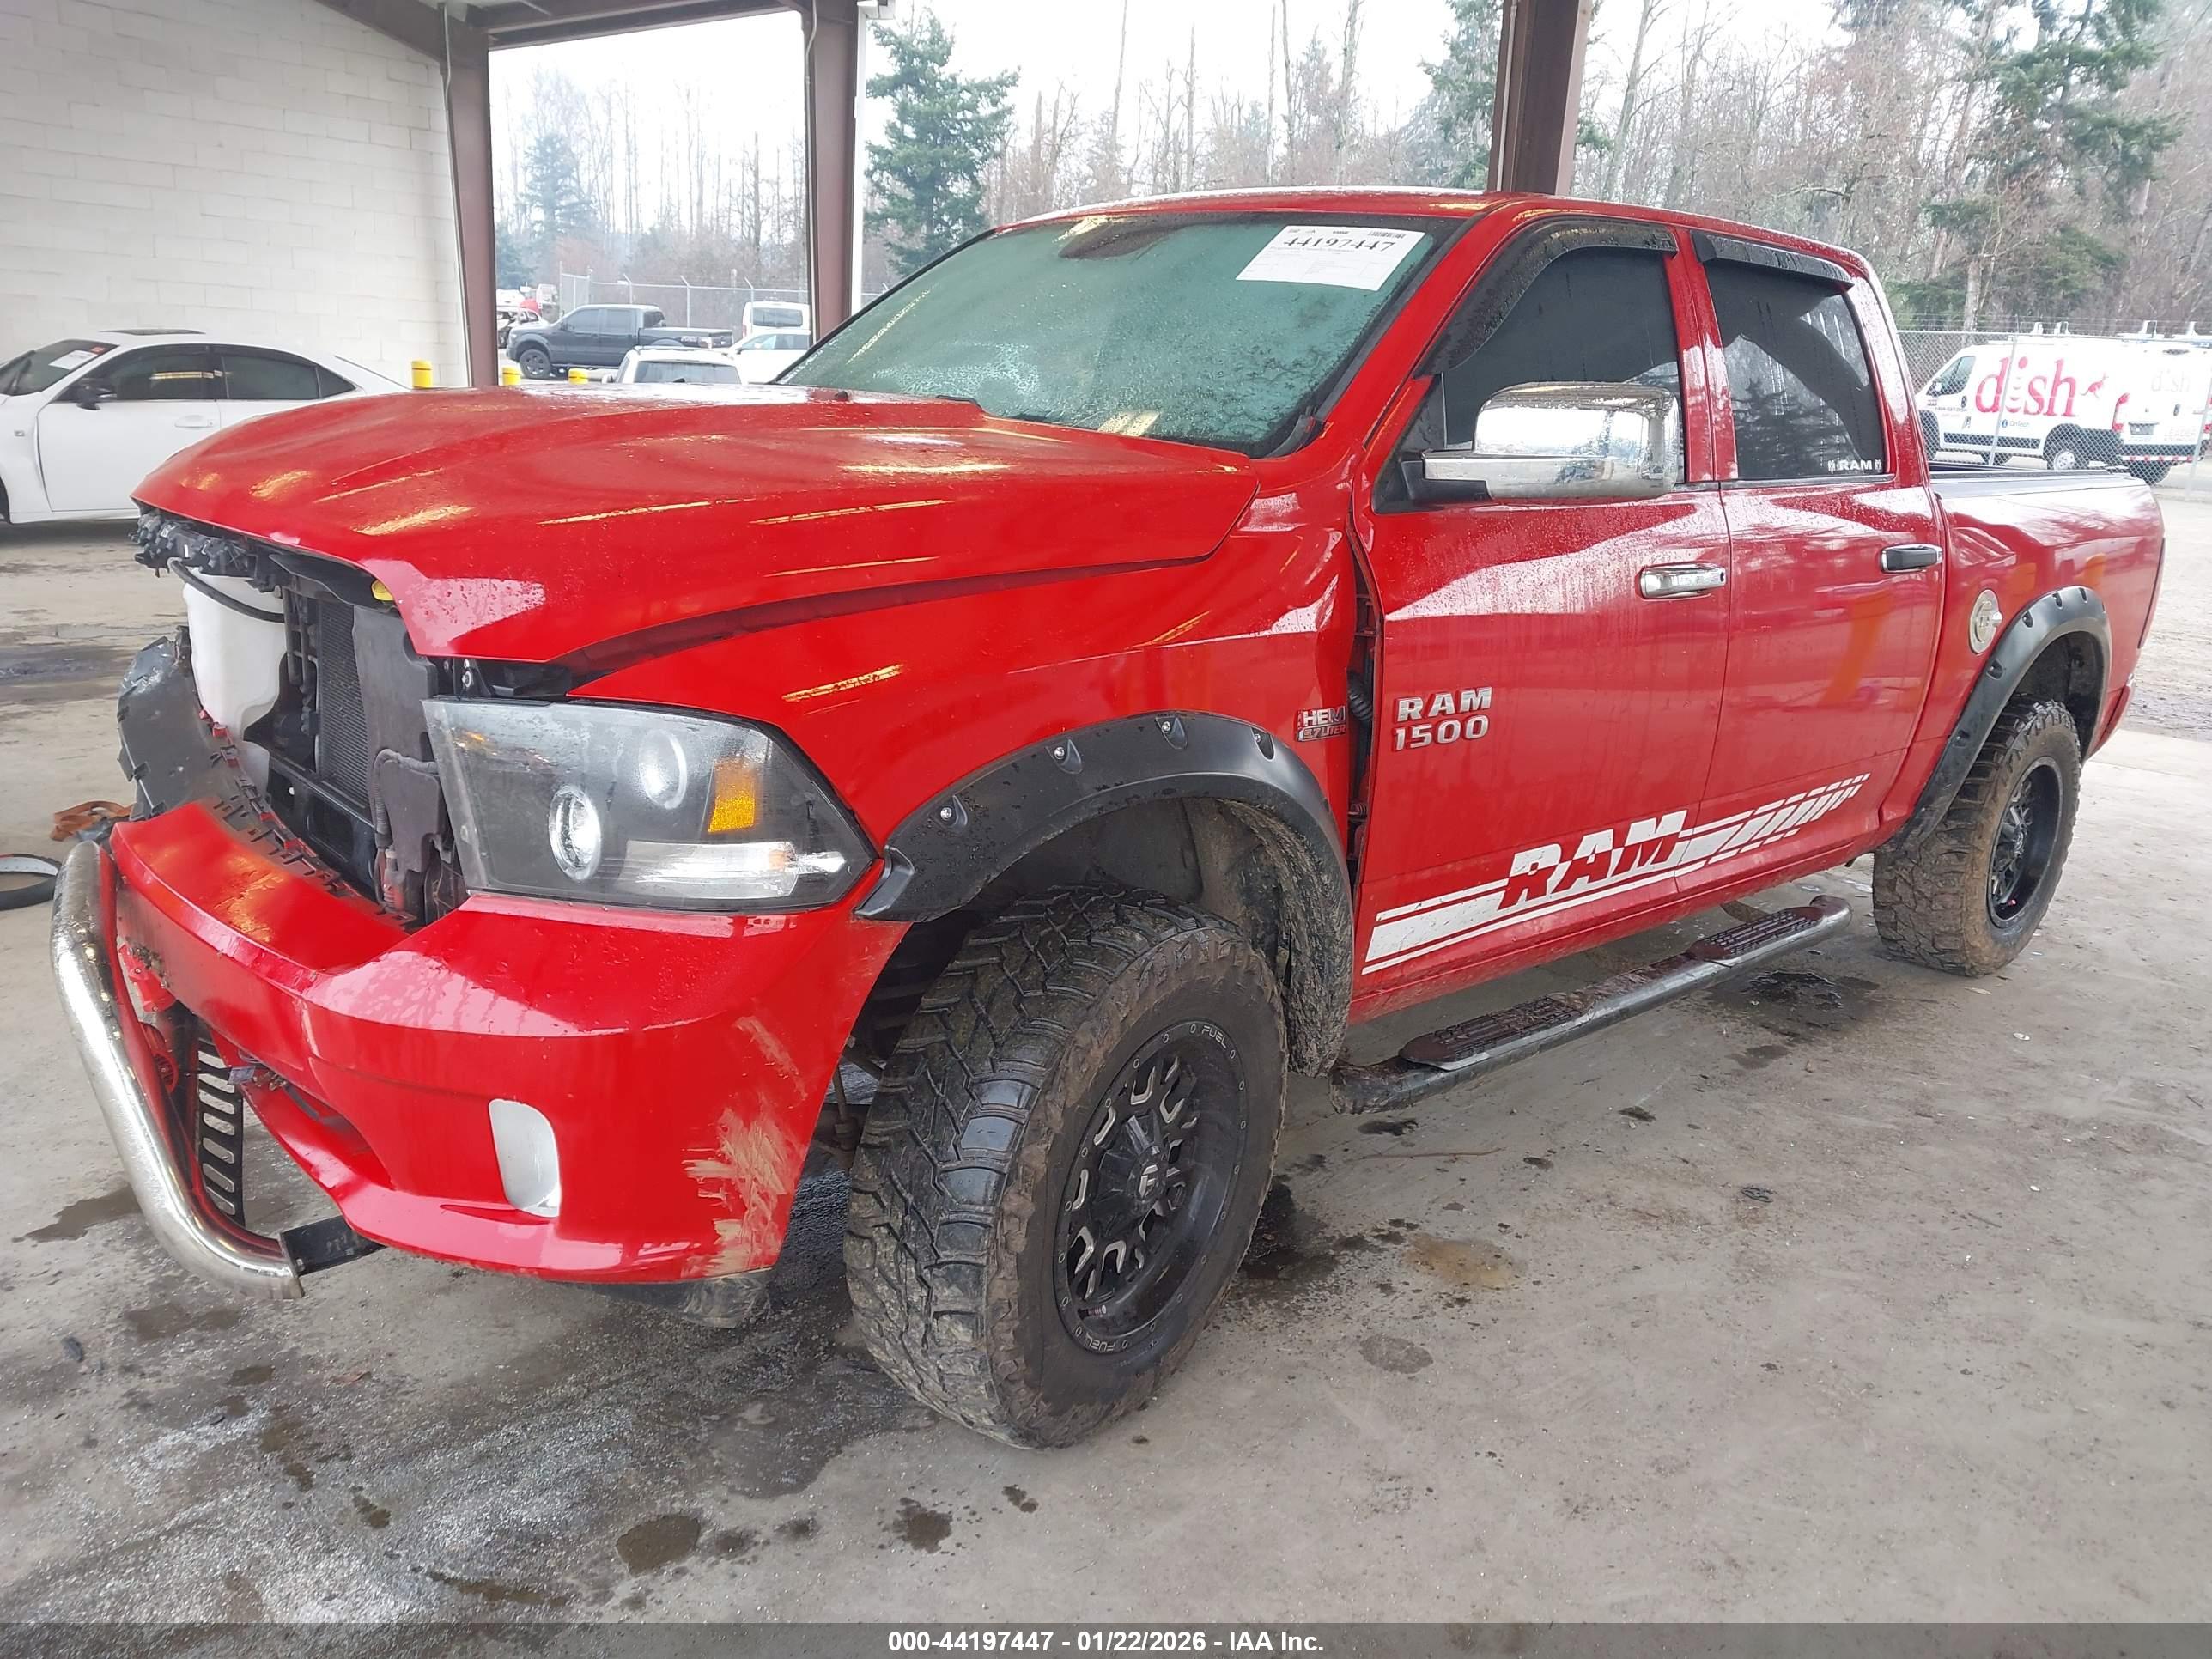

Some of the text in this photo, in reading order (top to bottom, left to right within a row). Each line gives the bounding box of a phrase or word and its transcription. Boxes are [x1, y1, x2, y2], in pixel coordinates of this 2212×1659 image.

[1284, 237, 1396, 252] 44197447
[1975, 356, 2076, 417] dish
[1838, 459, 1872, 471] RAM
[1303, 705, 1346, 726] HEMI
[1396, 686, 1492, 722] RAM
[1395, 714, 1489, 750] 1500
[1498, 810, 1687, 911] RAM
[1202, 1025, 1227, 1049] FUEL
[1085, 1332, 1116, 1352] FUEL
